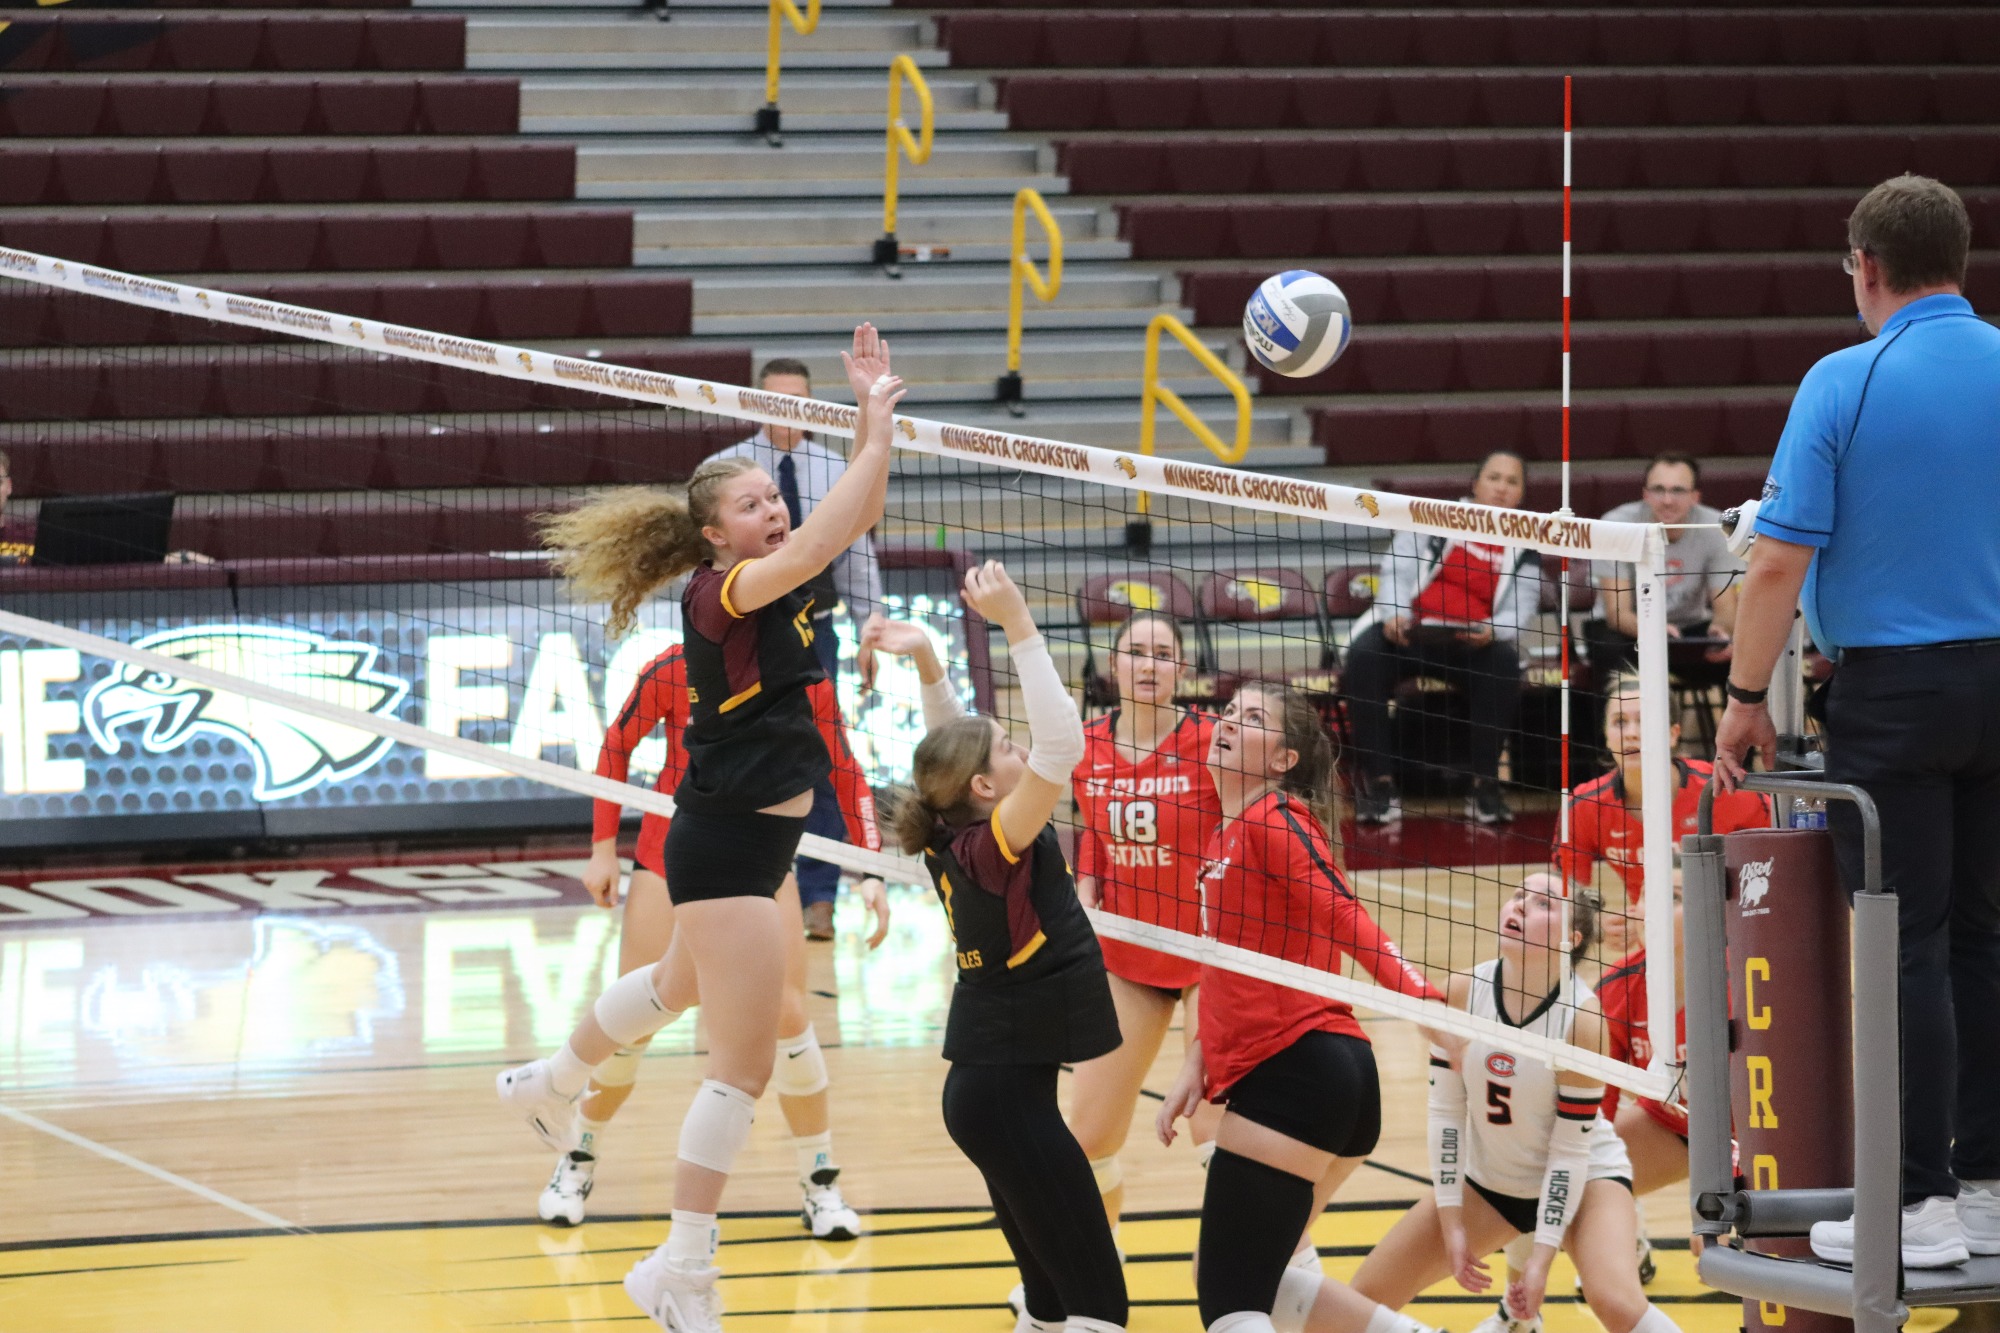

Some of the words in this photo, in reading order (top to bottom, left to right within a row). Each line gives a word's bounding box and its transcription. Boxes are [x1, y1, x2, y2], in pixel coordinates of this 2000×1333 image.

[553, 358, 612, 387] MINNESOTA
[613, 369, 678, 398] CROOKSTON
[738, 390, 801, 420] MINNESOTA
[803, 402, 858, 429] CROOKST
[941, 427, 1009, 457] MINNESOTA
[1012, 439, 1090, 472] CROOKSTON
[1163, 464, 1242, 498] MINNESOTA
[1243, 477, 1328, 511] CROOKSTON
[1409, 500, 1497, 535] MINNESOTA
[1110, 776, 1190, 797] CLOUD
[1106, 801, 1158, 843] 18
[1106, 844, 1173, 868] STATE
[1486, 1080, 1512, 1126] 5
[1441, 1128, 1458, 1164] CLOUD
[1544, 1170, 1570, 1227] HUSKIES
